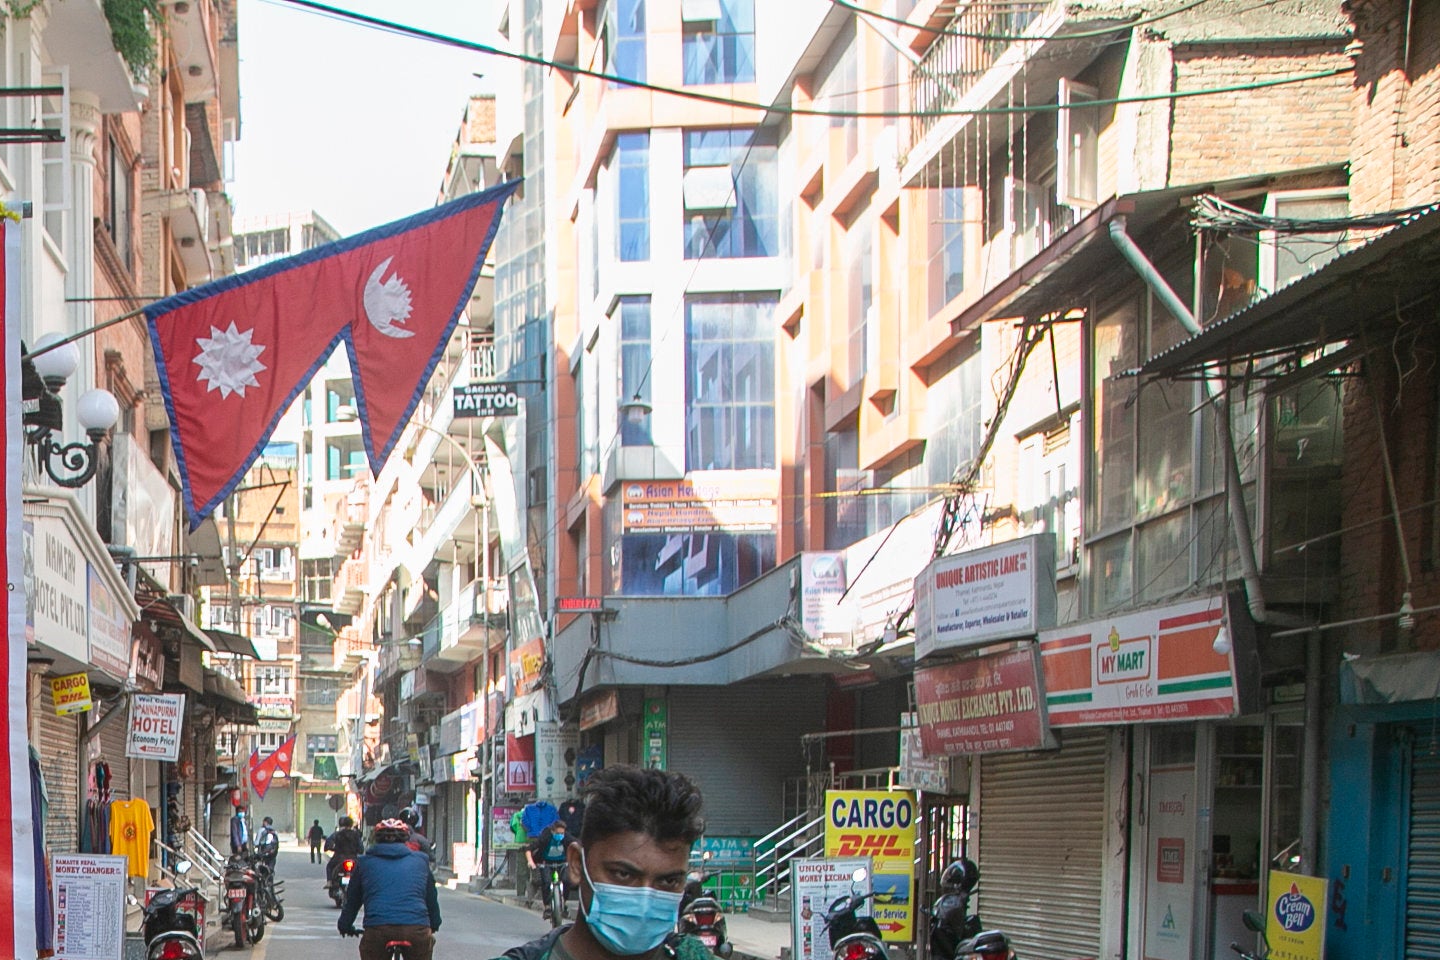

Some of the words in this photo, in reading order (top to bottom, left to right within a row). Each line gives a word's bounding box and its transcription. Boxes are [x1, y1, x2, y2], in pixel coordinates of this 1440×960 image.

[464, 384, 507, 394] GAGAN'S
[454, 392, 518, 410] TATTOO
[646, 485, 673, 499] Asian
[936, 567, 964, 590] UNIQUE
[964, 559, 999, 583] ARTISTIC
[999, 553, 1020, 576] LANE
[1101, 655, 1116, 674] MY
[1117, 650, 1145, 673] MART
[53, 675, 87, 692] CARGO
[60, 692, 85, 704] DHL
[940, 697, 961, 723] MONEY
[962, 692, 999, 719] EXCHANGE
[998, 689, 1017, 715] PVT.
[1017, 685, 1037, 712] LTD.
[140, 704, 177, 717] ANNAPURNA
[133, 717, 176, 735] HOTEL
[646, 721, 666, 729] ATM
[133, 733, 159, 746] Economy
[160, 736, 175, 746] Price
[831, 798, 912, 829] CARGO
[711, 838, 738, 849] ATM
[838, 834, 903, 857] DHL
[55, 865, 80, 874] MONEY
[81, 866, 115, 875] CHANGER
[799, 864, 835, 873] UNIQUE
[799, 874, 823, 883] MONEY
[729, 888, 761, 899] ATM
[1279, 897, 1311, 916] Cream
[883, 908, 907, 920] Service
[1284, 913, 1304, 929] Bell
